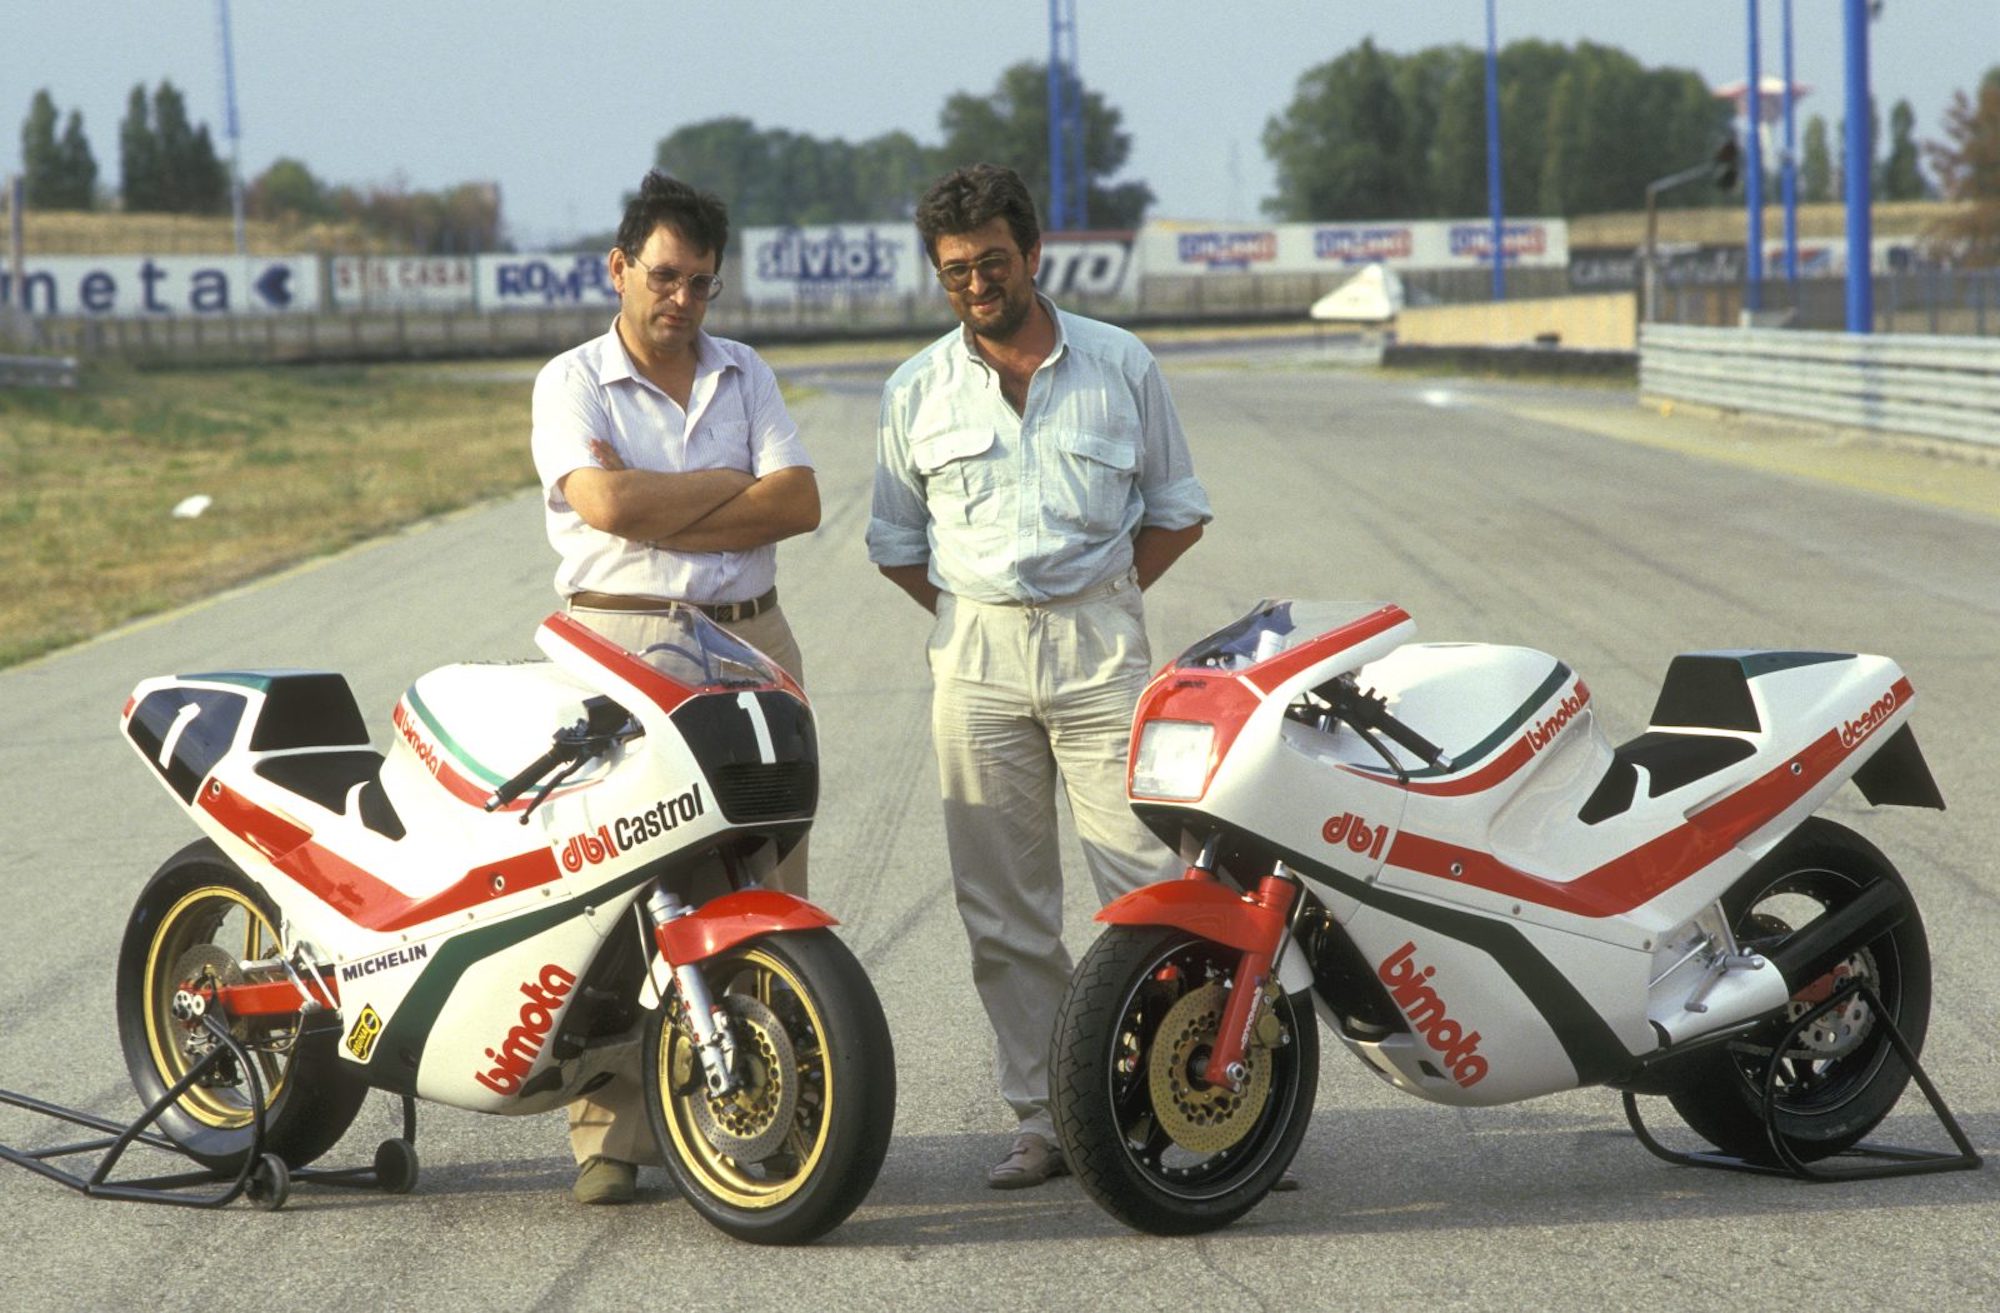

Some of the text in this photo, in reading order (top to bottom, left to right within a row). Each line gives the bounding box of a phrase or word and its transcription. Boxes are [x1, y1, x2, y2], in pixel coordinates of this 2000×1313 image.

[398, 257, 468, 286] CASA
[158, 702, 202, 770] 1
[401, 711, 440, 775] bimota
[736, 691, 778, 764] 1
[1527, 693, 1581, 751] bimota
[1842, 692, 1894, 748] desmo
[562, 783, 704, 873] db1 Castrol
[1321, 812, 1389, 861] db1
[342, 944, 428, 983] MICHELIN
[474, 963, 577, 1097] bimota
[1378, 941, 1489, 1089] bimota
